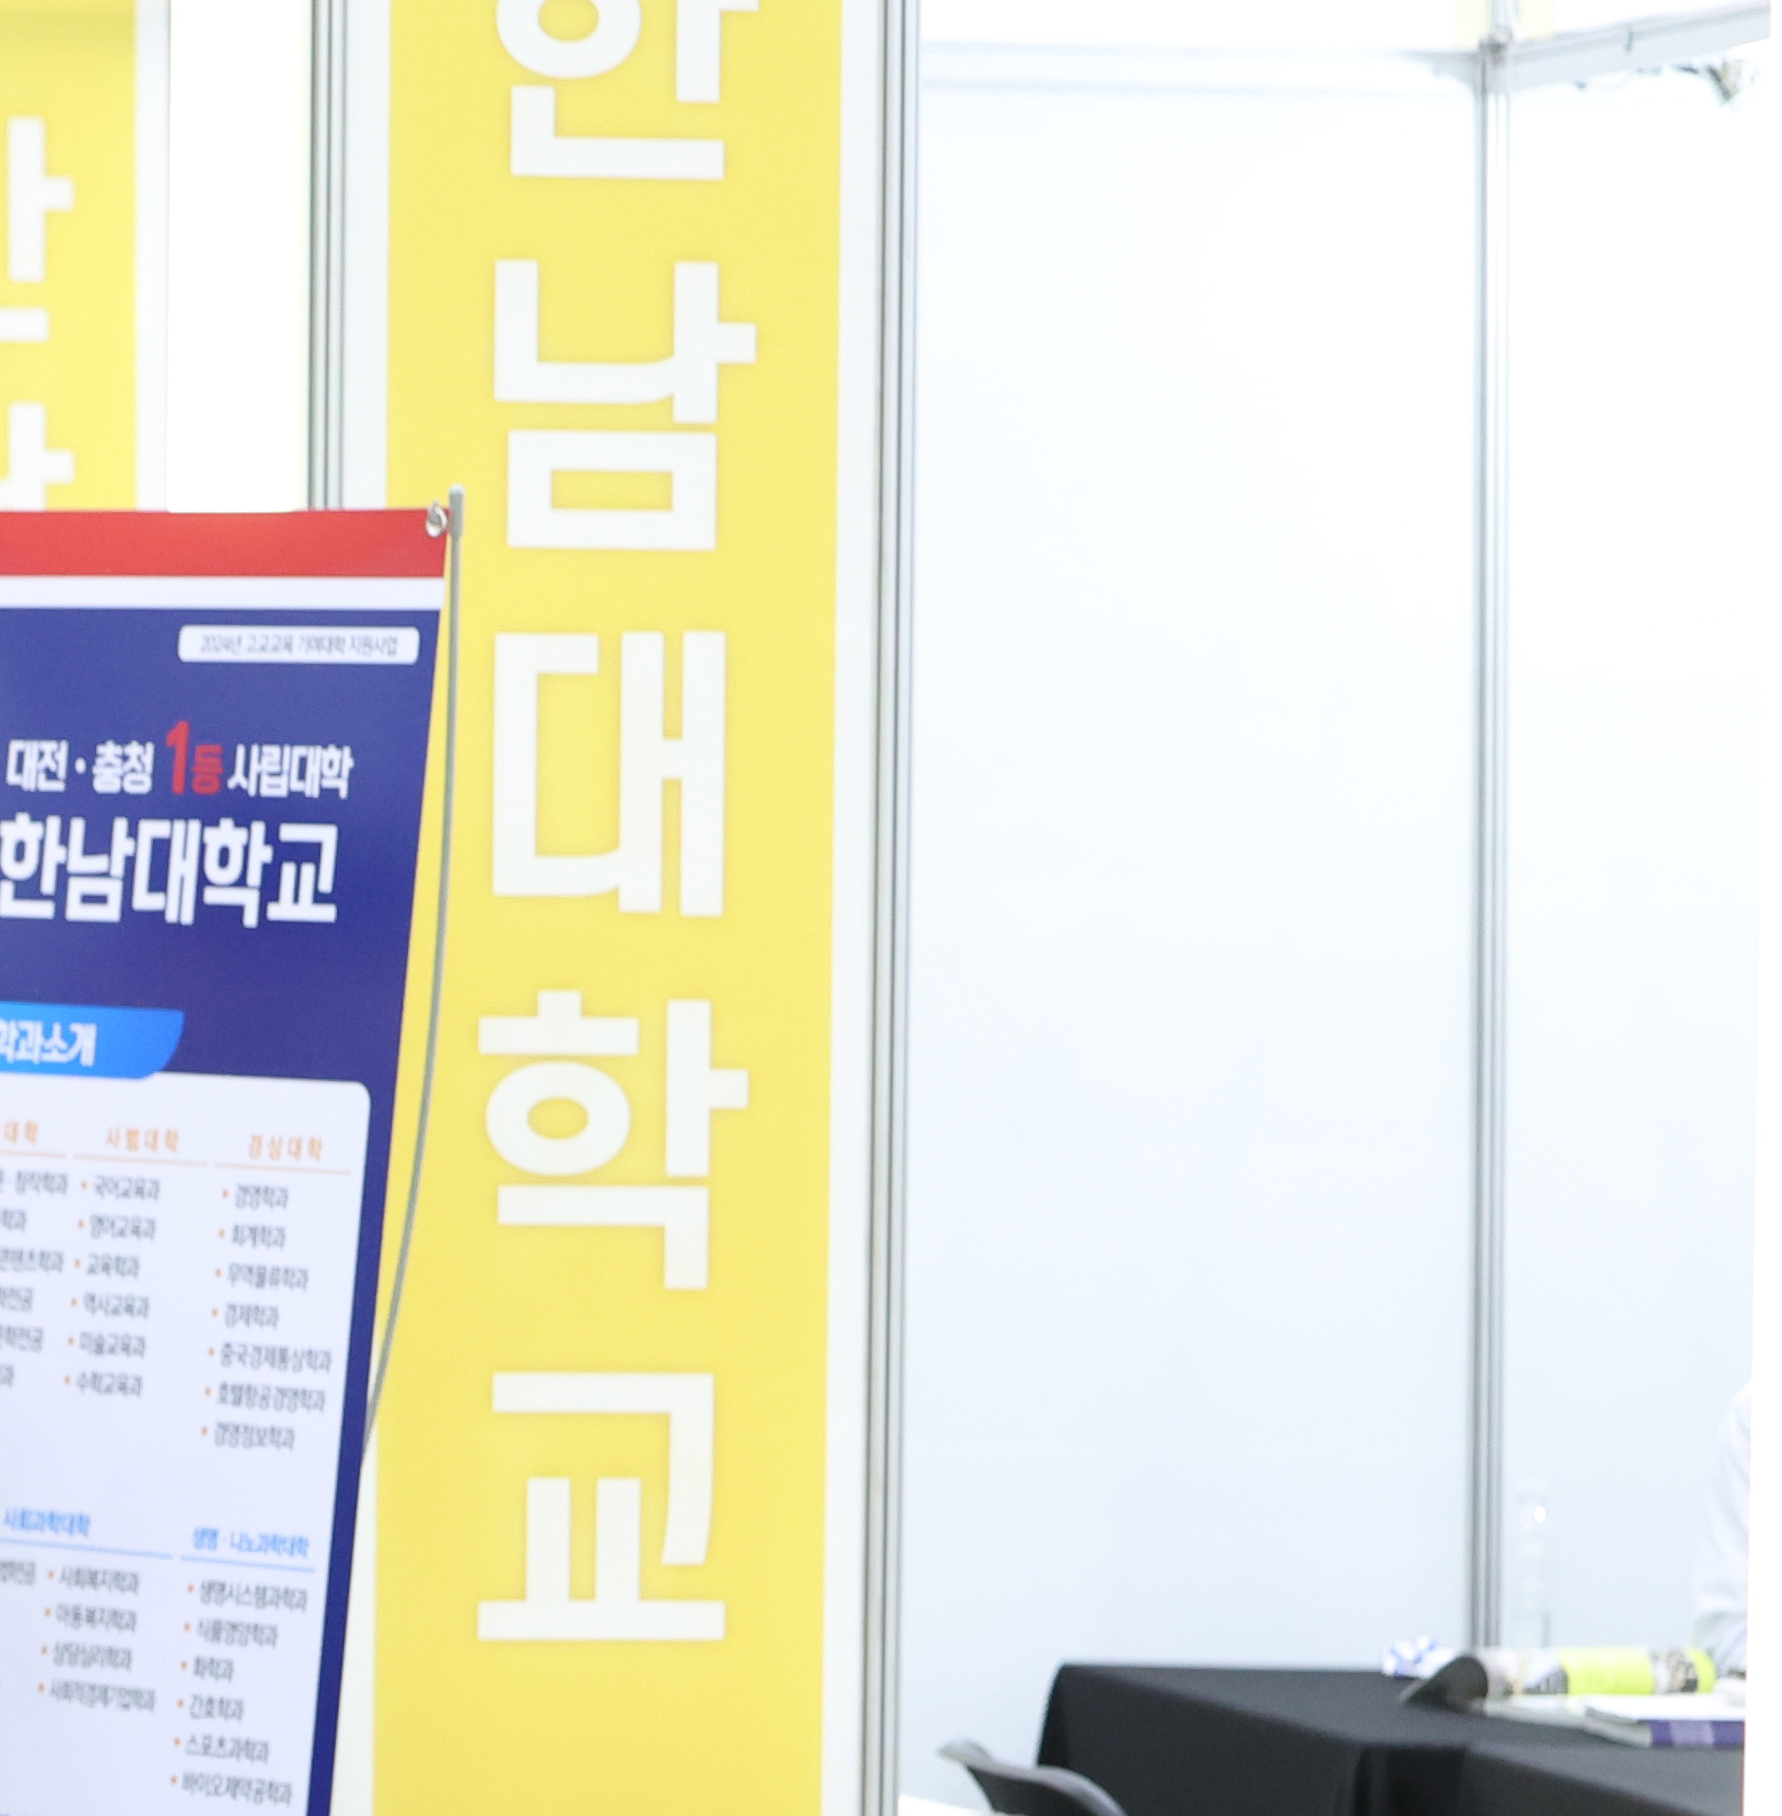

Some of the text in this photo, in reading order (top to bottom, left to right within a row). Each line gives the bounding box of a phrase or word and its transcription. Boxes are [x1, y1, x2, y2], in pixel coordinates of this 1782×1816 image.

[6, 738, 68, 793] 대전
[92, 739, 154, 795] 충청
[165, 720, 224, 796] 1등
[226, 742, 355, 800] 사립대학
[476, 0, 755, 1640] 한남대학교
